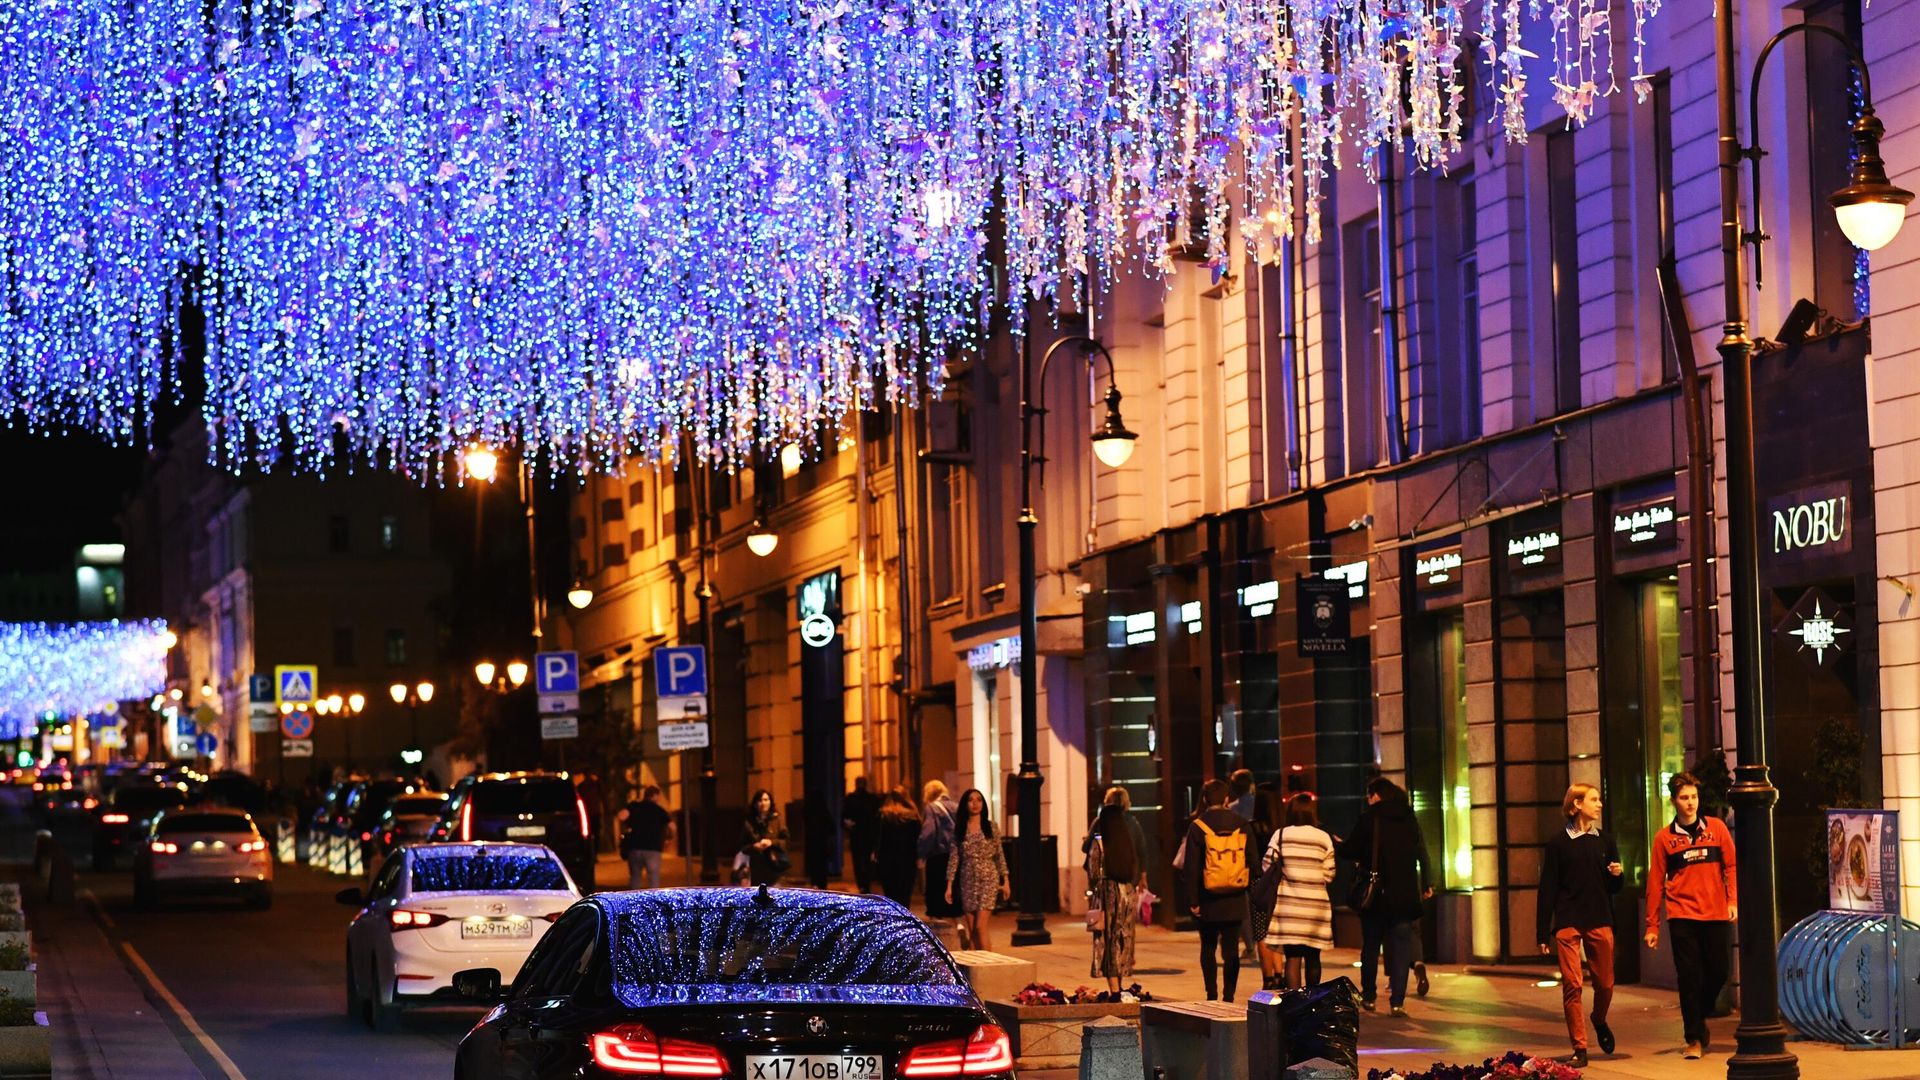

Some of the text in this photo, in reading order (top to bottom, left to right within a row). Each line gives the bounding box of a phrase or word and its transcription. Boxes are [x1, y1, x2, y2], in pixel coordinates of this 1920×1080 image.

[1773, 496, 1847, 554] NOBU
[1803, 621, 1835, 643] ROSE
[1302, 643, 1347, 652] NOVELLA
[545, 656, 569, 690] P
[668, 652, 697, 692] P
[843, 1056, 877, 1073] 799
